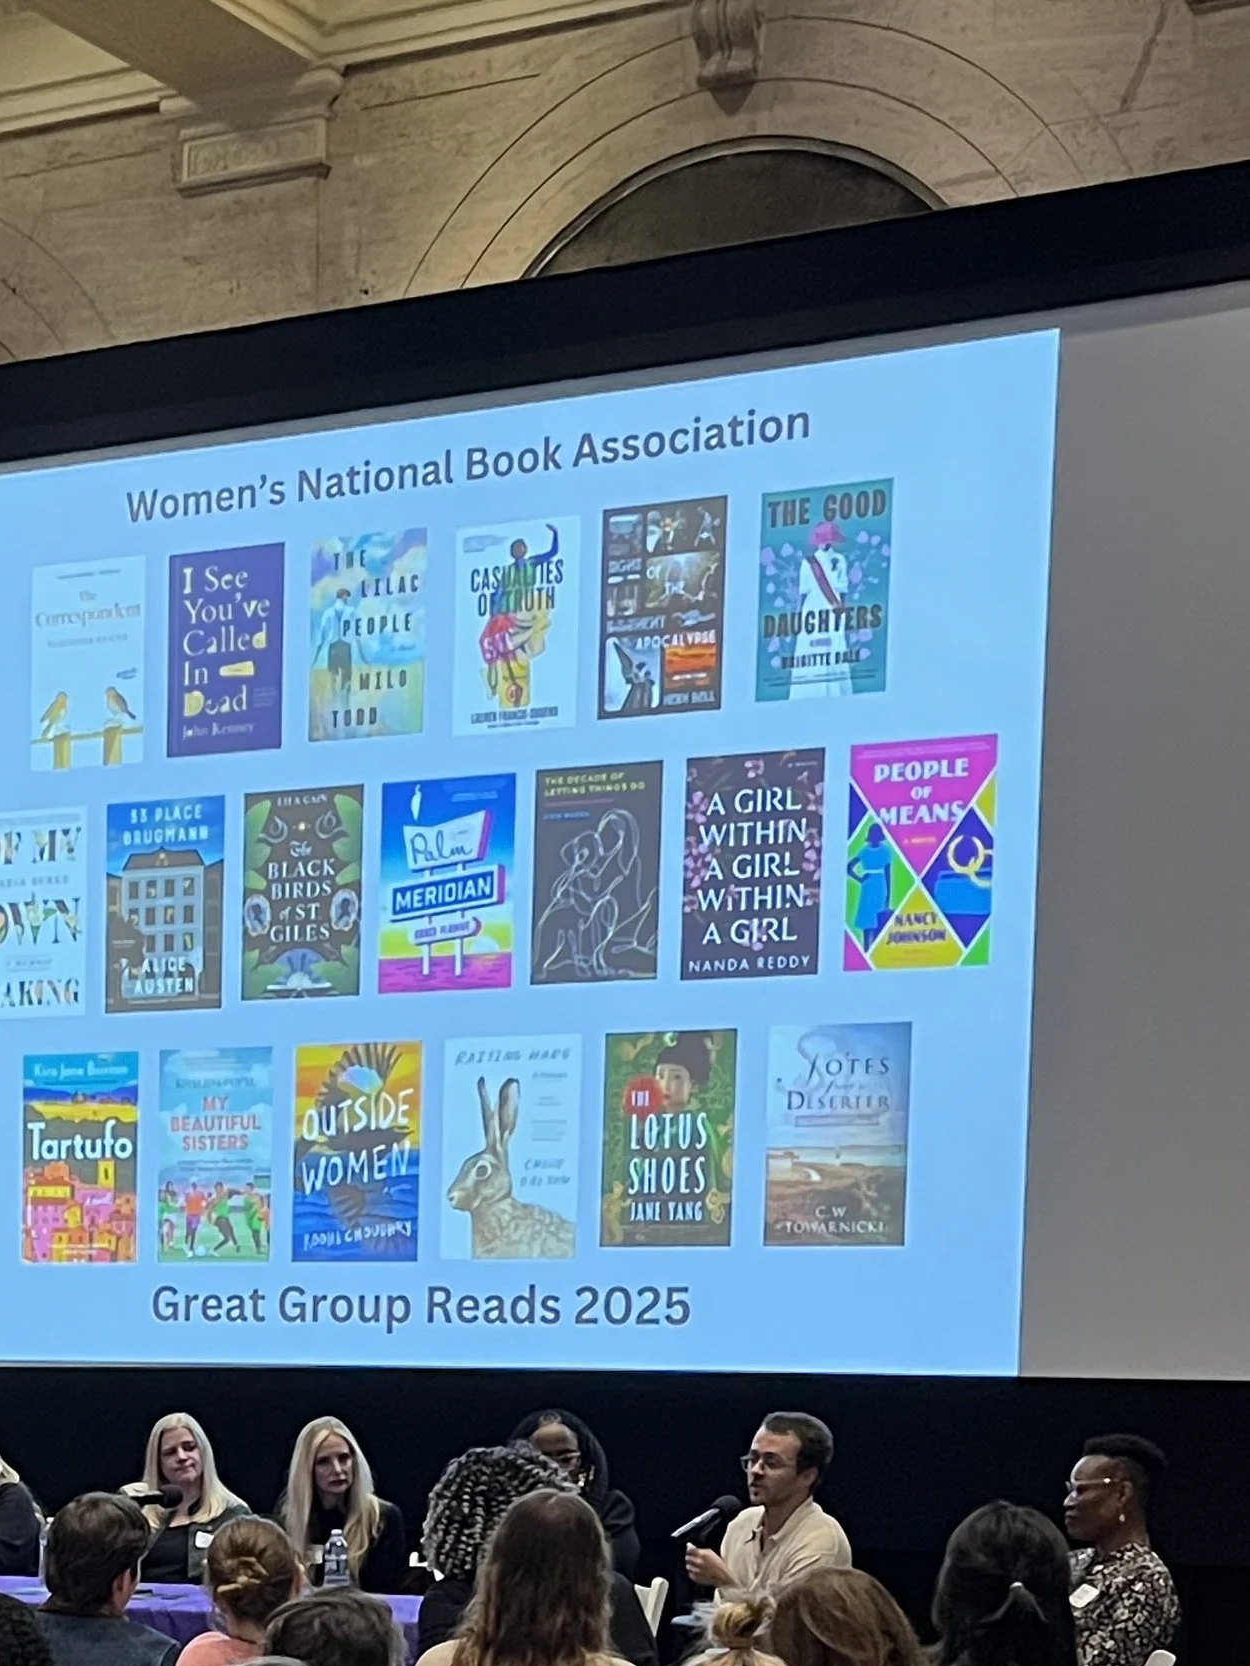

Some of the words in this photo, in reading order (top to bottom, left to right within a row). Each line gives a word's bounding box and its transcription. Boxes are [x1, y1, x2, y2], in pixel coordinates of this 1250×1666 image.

[128, 474, 285, 522] Women's
[298, 449, 452, 503] National
[466, 436, 561, 482] Book
[572, 408, 809, 469] Association
[768, 498, 810, 528] THE
[823, 489, 886, 522] GOOD
[334, 550, 366, 571] THE
[183, 568, 193, 594] I
[204, 566, 248, 592] See
[362, 574, 419, 598] LILAC
[470, 559, 563, 593] CASUALTIES
[184, 592, 270, 625] You've
[478, 593, 499, 617] OF
[507, 586, 554, 614] TRUTH
[343, 613, 412, 637] PEOPLE
[764, 604, 882, 638] DAUGHTERS
[183, 622, 267, 656] Called
[636, 630, 716, 650] APOCALYPSE
[184, 661, 208, 686] In
[183, 685, 247, 717] Dead
[331, 707, 377, 729] TODD
[874, 758, 969, 783] PEOPLE
[706, 792, 725, 816] A
[734, 787, 802, 813] GIRL
[910, 786, 933, 800] OF
[155, 804, 202, 822] PLACE
[879, 801, 965, 825] MEANS
[123, 825, 209, 845] BRUGMANN
[700, 818, 807, 847] WITHIN
[411, 830, 472, 865] Palm
[268, 858, 335, 880] BLACK
[704, 858, 723, 881] A
[732, 852, 800, 879] GIRL
[271, 880, 332, 900] BIRDS
[396, 876, 491, 911] MERIDIAN
[697, 884, 805, 911] WITHIN
[702, 922, 721, 945] A
[730, 917, 797, 943] GIRL
[894, 911, 937, 927] NANCY
[270, 924, 329, 943] GILES
[886, 929, 946, 945] JOHNSON
[142, 956, 186, 973] ALICE
[689, 958, 749, 973] NANDA
[757, 955, 810, 969] REDDY
[134, 977, 194, 994] AUSTEN
[203, 1096, 228, 1111] MY
[787, 1090, 890, 1110] DESERTER
[171, 1114, 261, 1132] BEAUTIFUL
[302, 1089, 414, 1141] OUTSIDE
[27, 1119, 133, 1160] Tartufo
[183, 1134, 248, 1151] SISTERS
[631, 1112, 707, 1150] LOTUS
[302, 1141, 410, 1195] WOMEN
[628, 1157, 705, 1194] SHOES
[630, 1202, 661, 1221] JANE
[668, 1201, 702, 1221] YANG
[785, 1220, 883, 1234] TOWARNICKI
[152, 1286, 266, 1323] Great
[279, 1286, 411, 1334] Group
[427, 1285, 561, 1324] Reads
[574, 1286, 690, 1326] 2025
